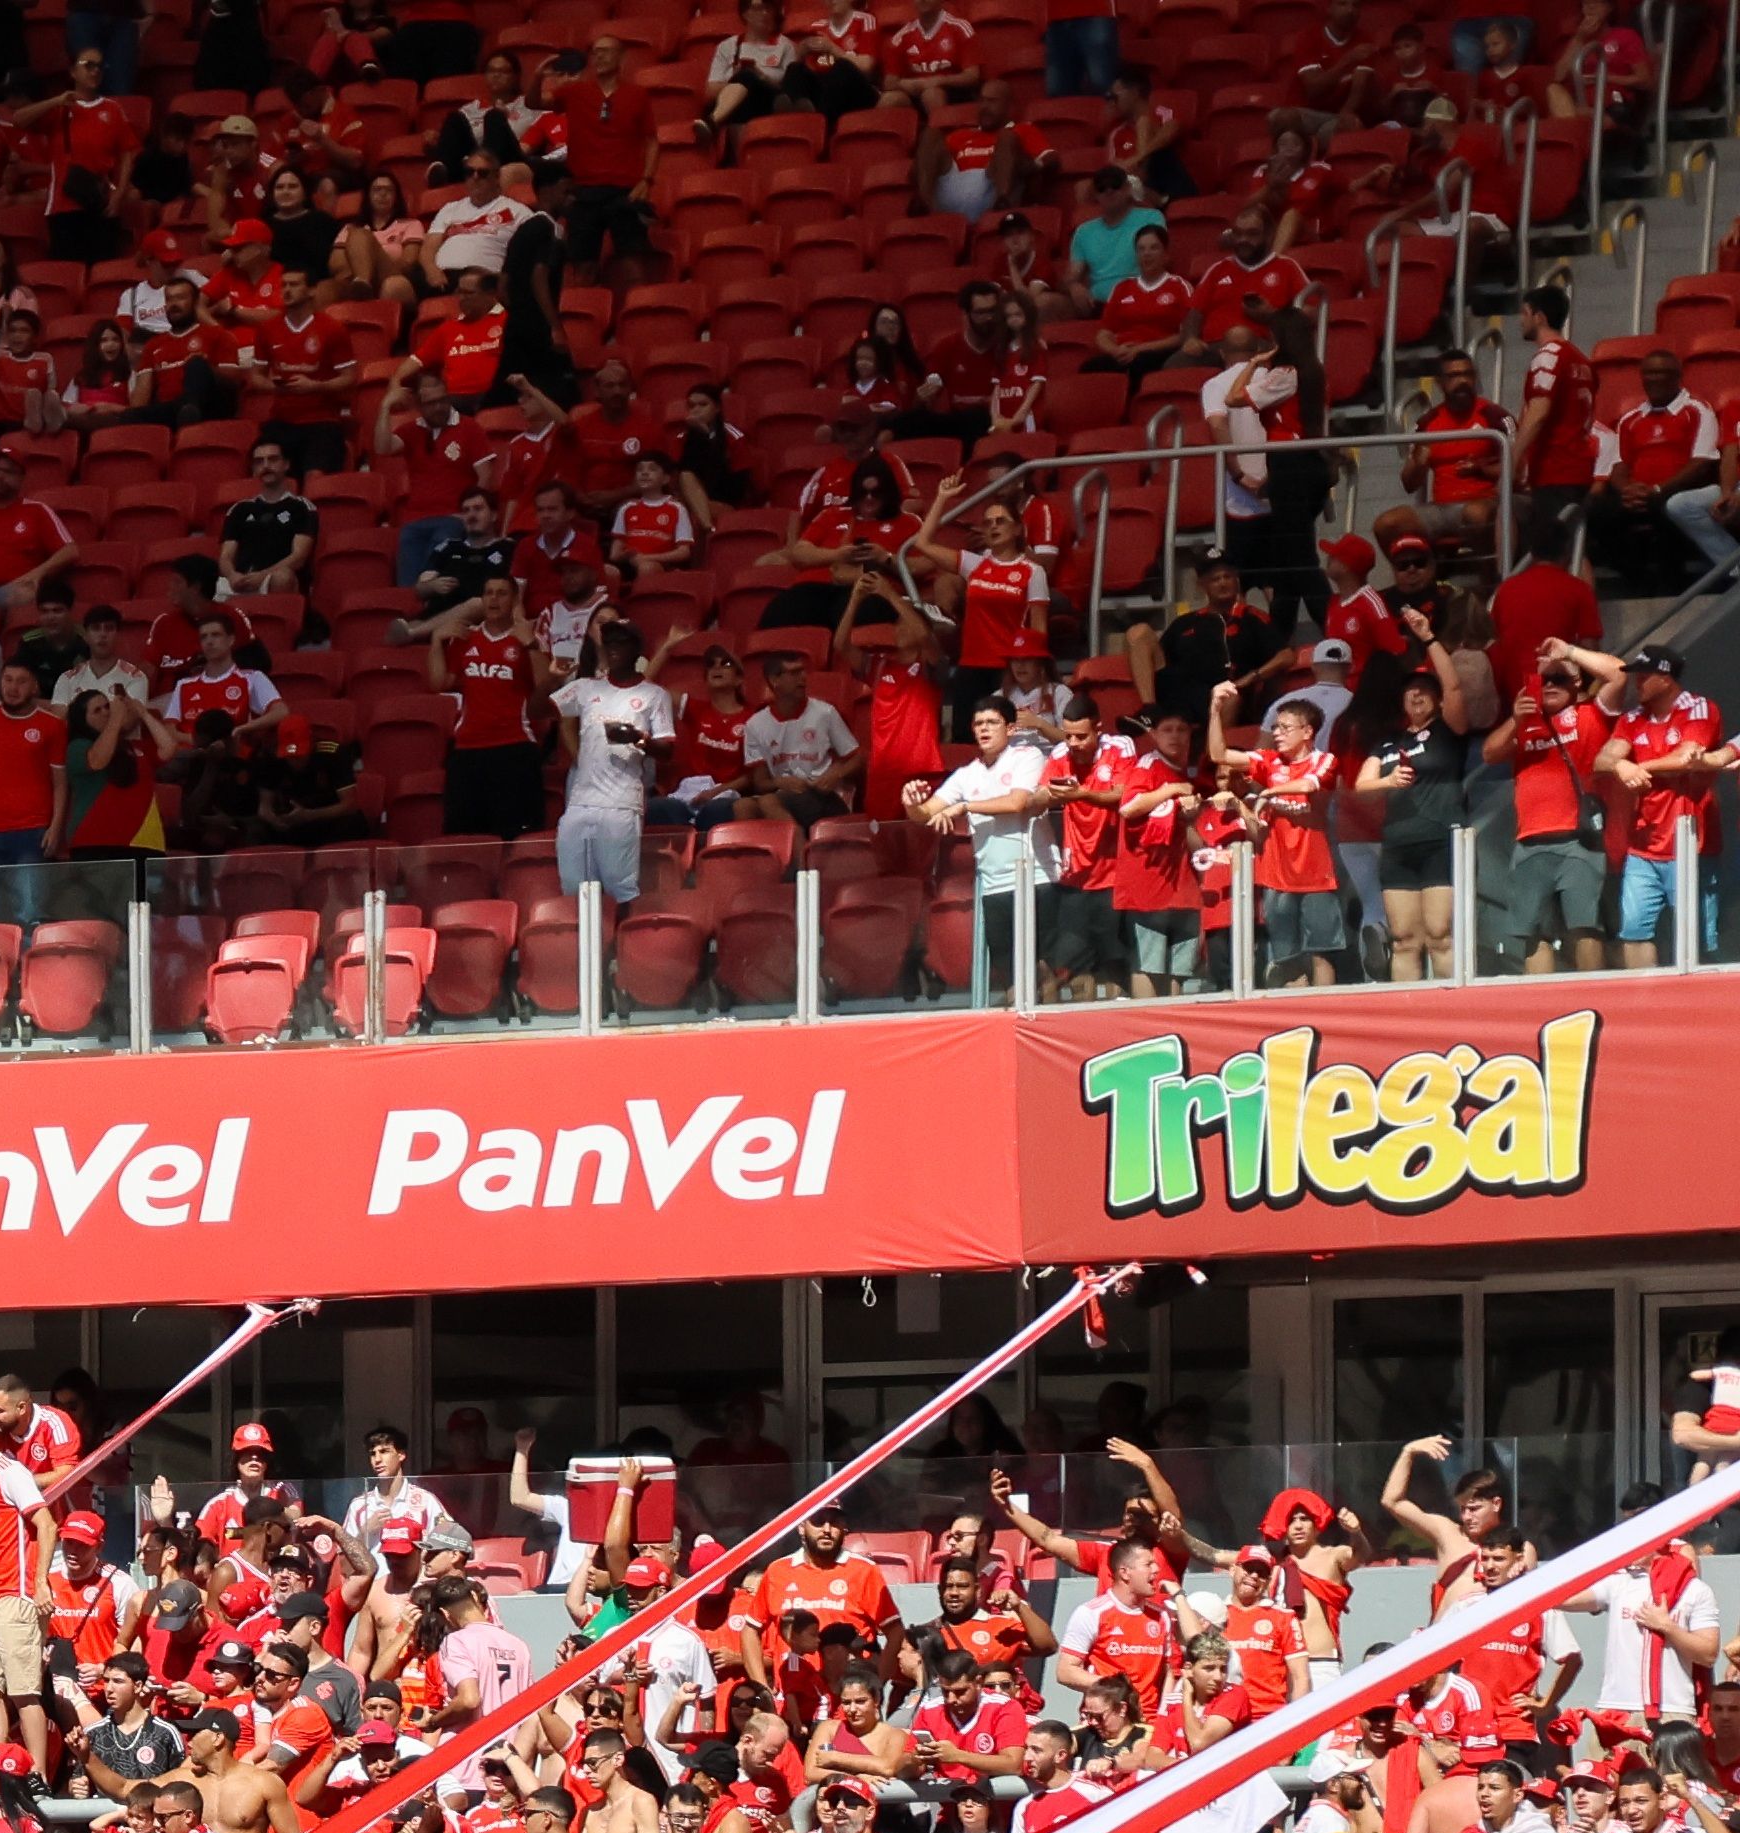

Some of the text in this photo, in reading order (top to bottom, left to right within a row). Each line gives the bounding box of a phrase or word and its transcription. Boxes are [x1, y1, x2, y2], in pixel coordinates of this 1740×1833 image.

[465, 664, 513, 679] alfa
[1081, 1009, 1601, 1218] Trilegal
[368, 1089, 846, 1216] PanVel
[792, 1597, 845, 1611] Banrisul
